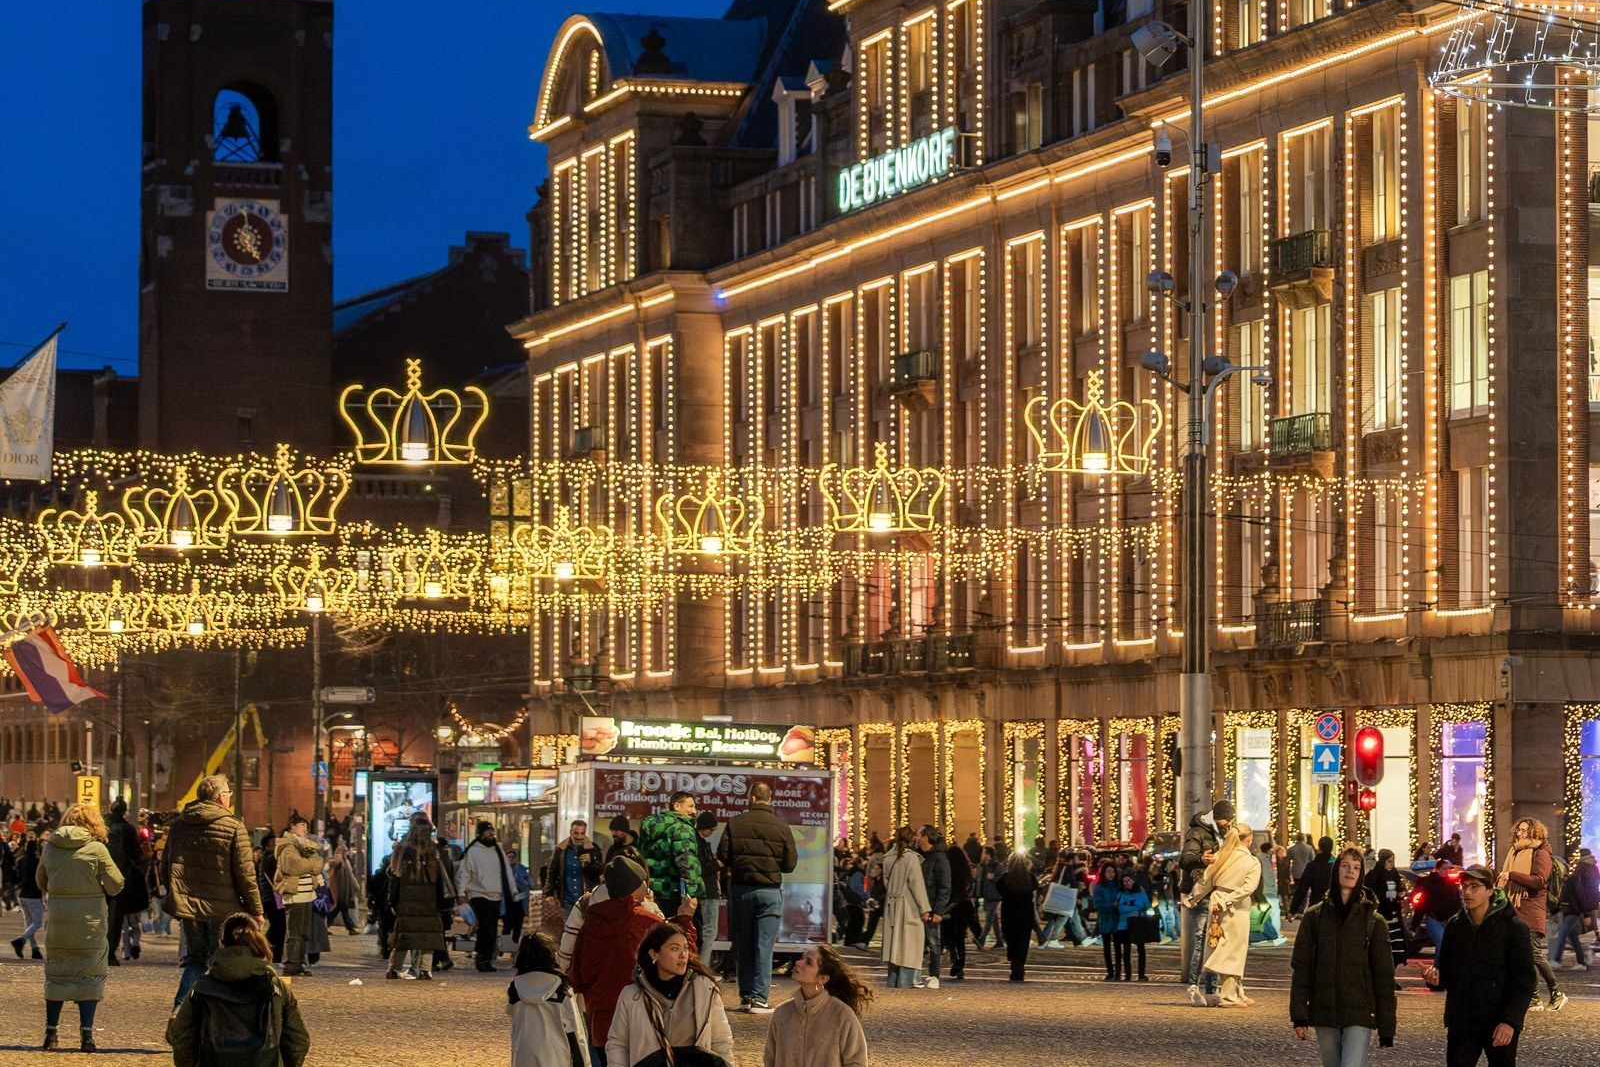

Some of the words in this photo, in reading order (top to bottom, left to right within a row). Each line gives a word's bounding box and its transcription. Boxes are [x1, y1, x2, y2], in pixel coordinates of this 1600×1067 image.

[839, 163, 863, 214] DE
[863, 125, 956, 204] BIJENKORF
[4, 452, 39, 465] DIOR
[623, 770, 748, 795] HOTDOGS
[771, 798, 812, 808] eenham
